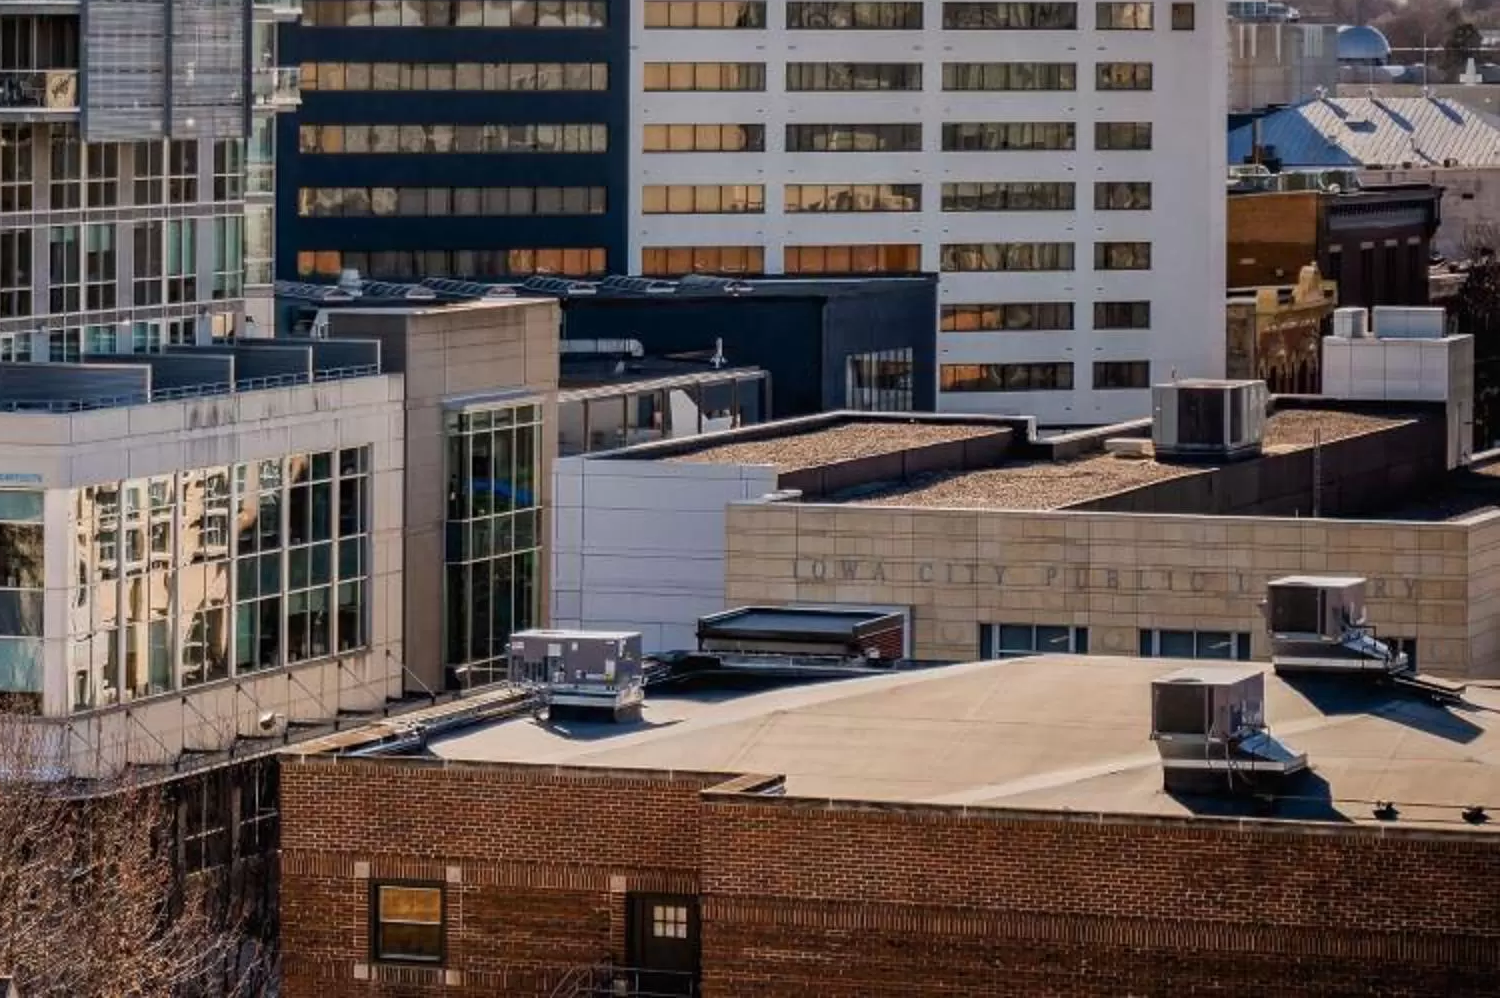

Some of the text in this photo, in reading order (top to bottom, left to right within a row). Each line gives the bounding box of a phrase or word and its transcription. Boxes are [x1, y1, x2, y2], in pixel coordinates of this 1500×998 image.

[792, 558, 886, 582] IOWA
[918, 561, 1007, 585] CITY
[1046, 564, 1207, 592] PUBLIC
